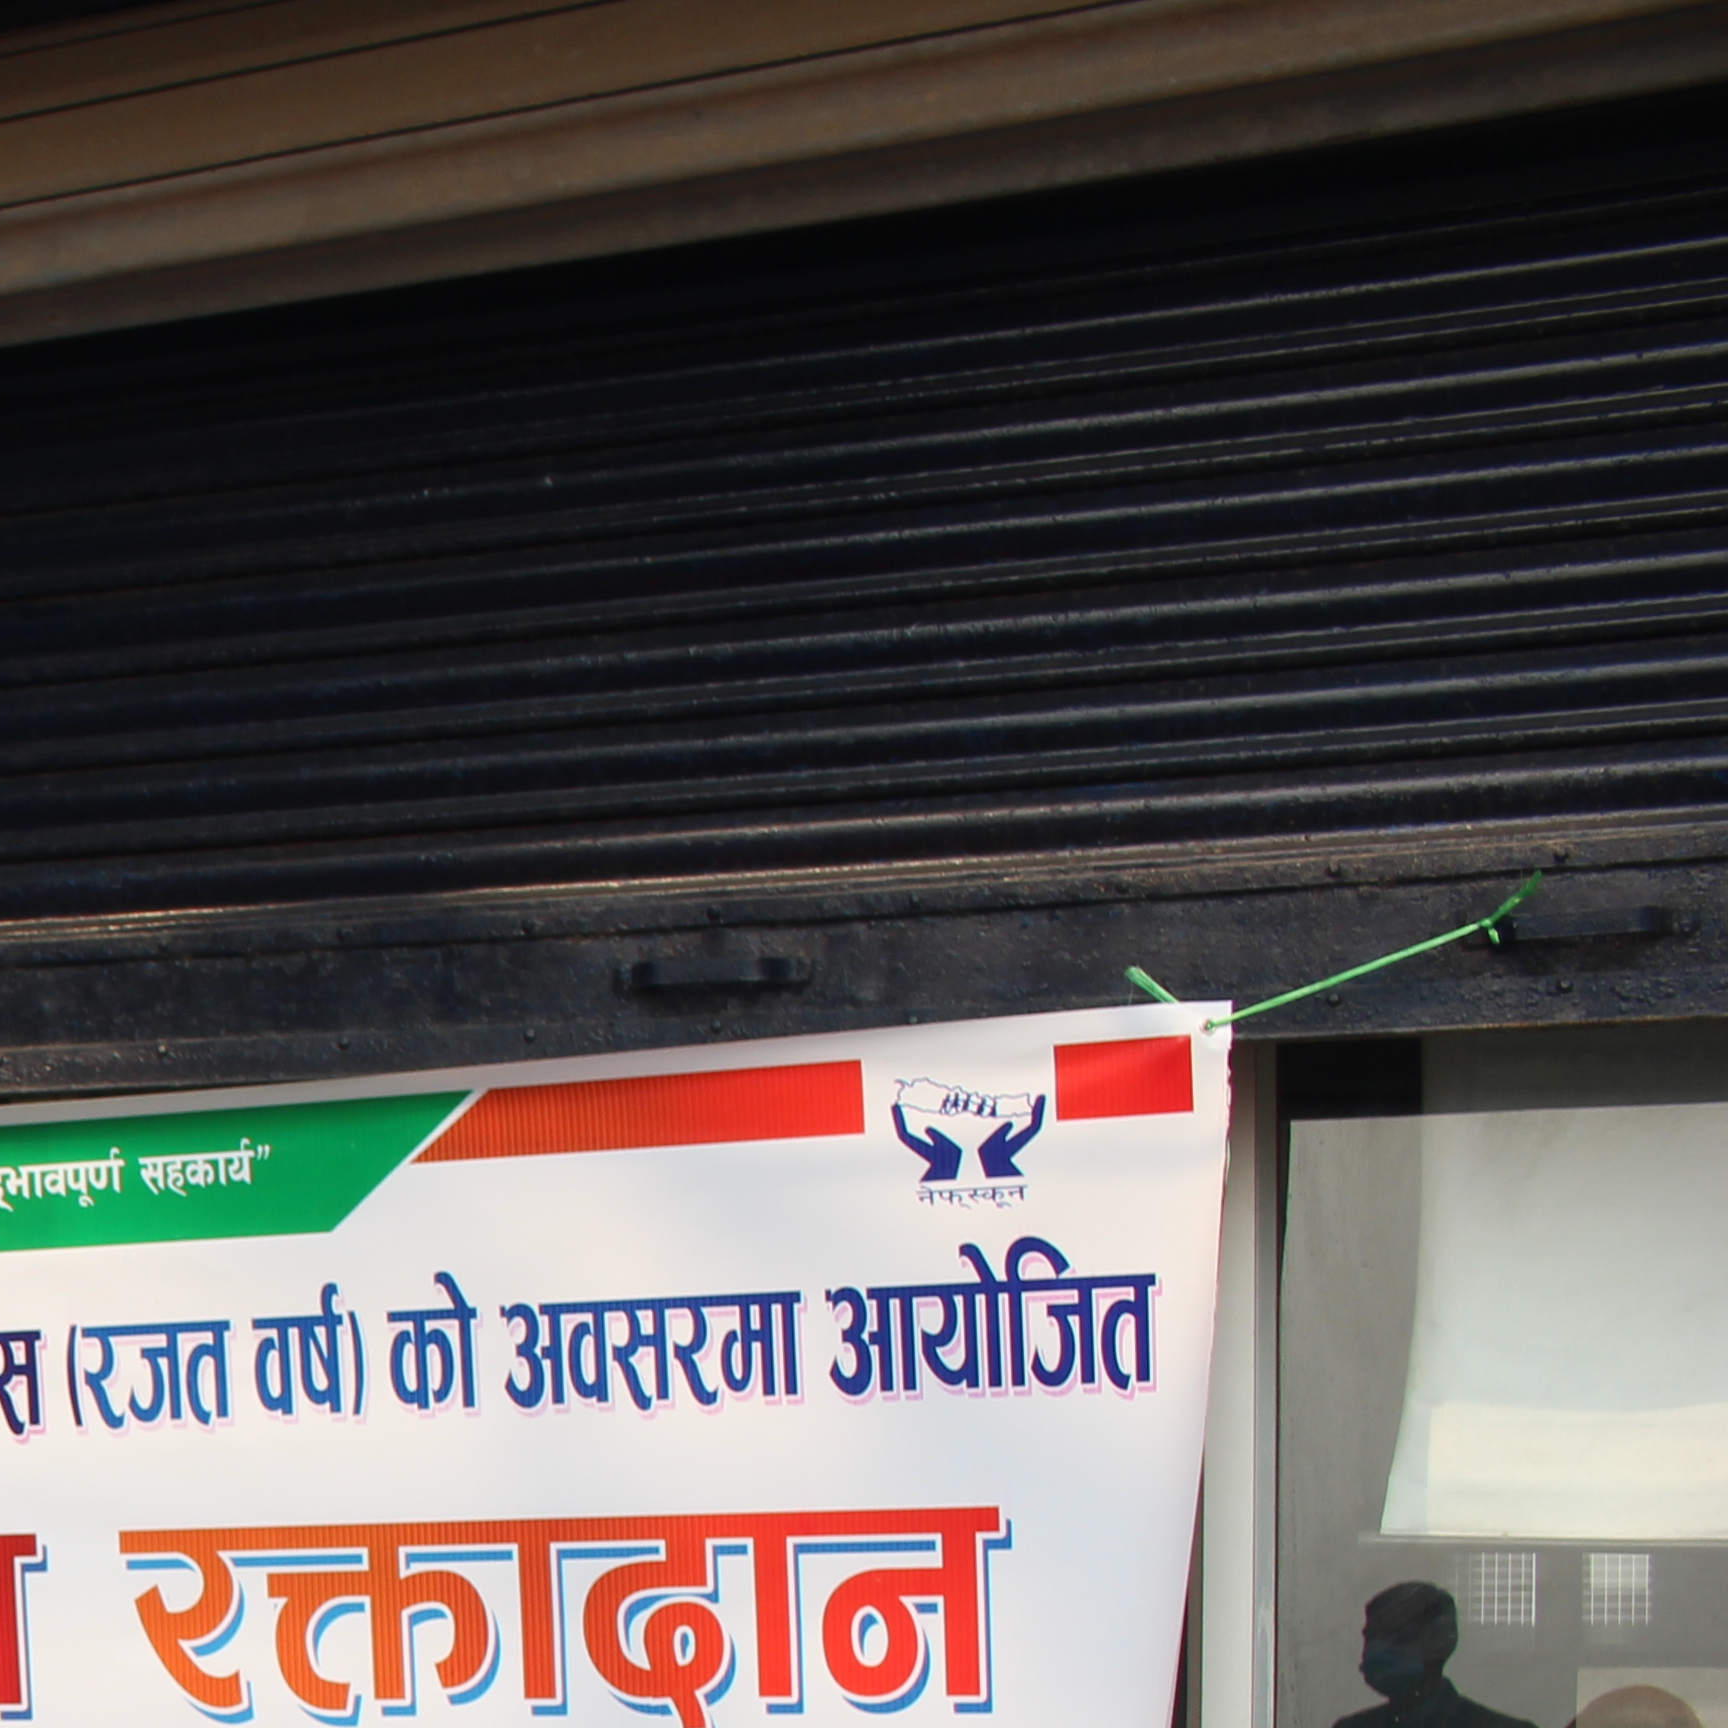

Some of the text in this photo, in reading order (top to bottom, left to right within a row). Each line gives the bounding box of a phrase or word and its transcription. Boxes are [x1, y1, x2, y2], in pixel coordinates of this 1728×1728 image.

[68, 1318, 232, 1428] (रजत
[252, 1282, 367, 1418] वर्ष)
[386, 1271, 479, 1410] को
[500, 1290, 802, 1411] अवसरमा
[825, 1235, 1158, 1397] आयोजित
